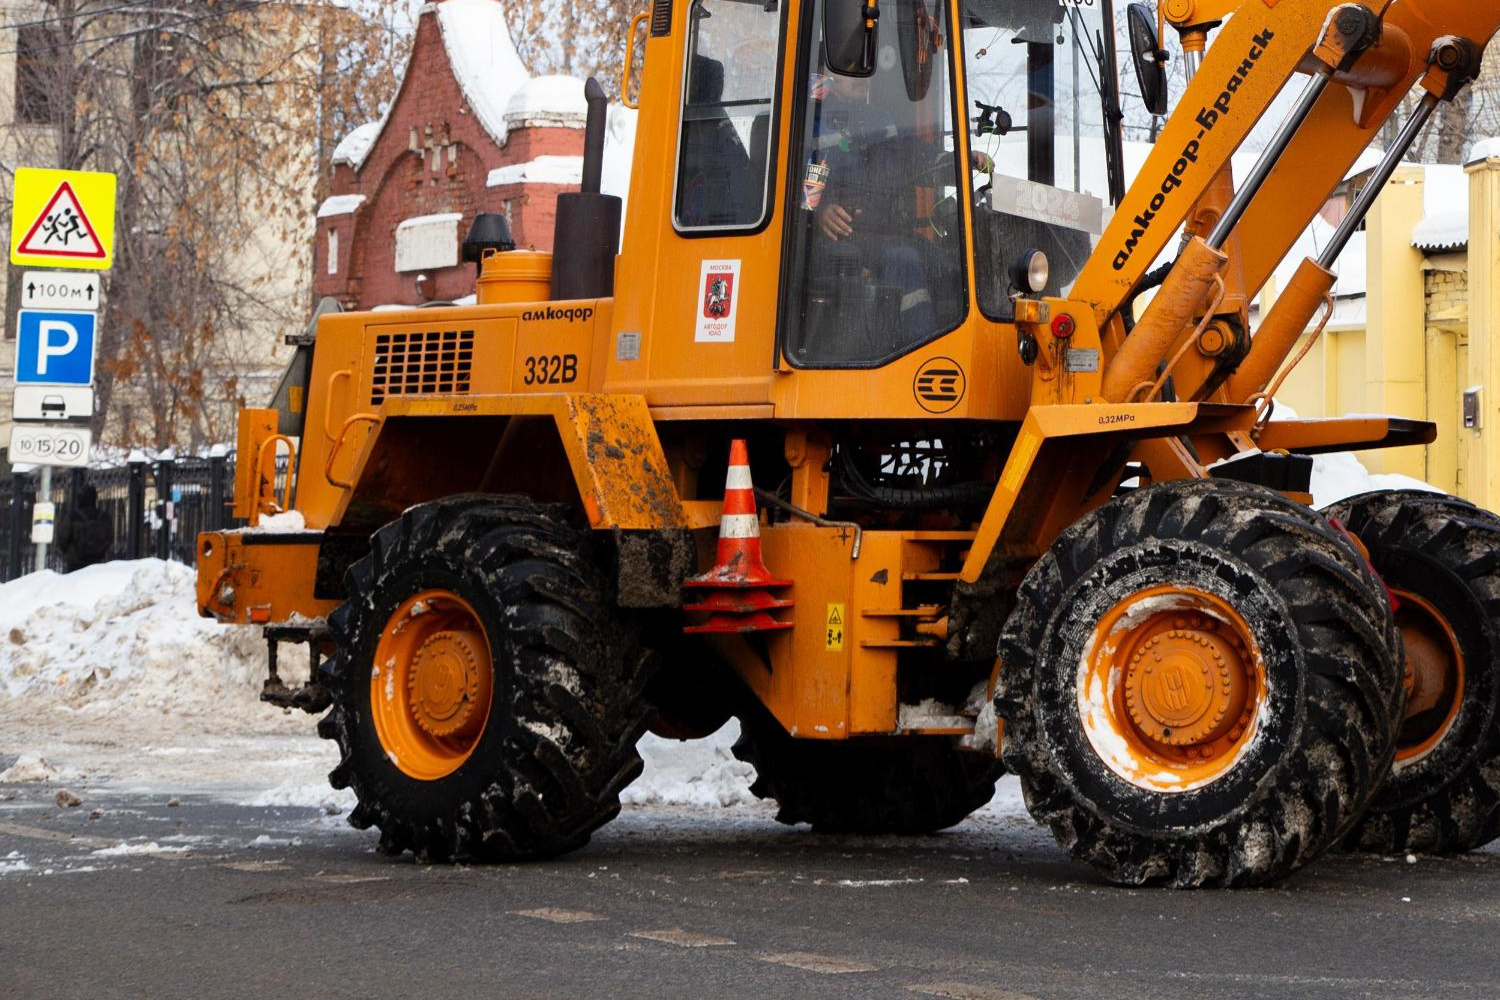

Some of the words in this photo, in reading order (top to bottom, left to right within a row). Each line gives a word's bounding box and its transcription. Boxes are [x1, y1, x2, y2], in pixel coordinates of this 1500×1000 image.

[20, 440, 31, 450] 10
[38, 440, 50, 453] 15
[57, 440, 80, 455] 20
